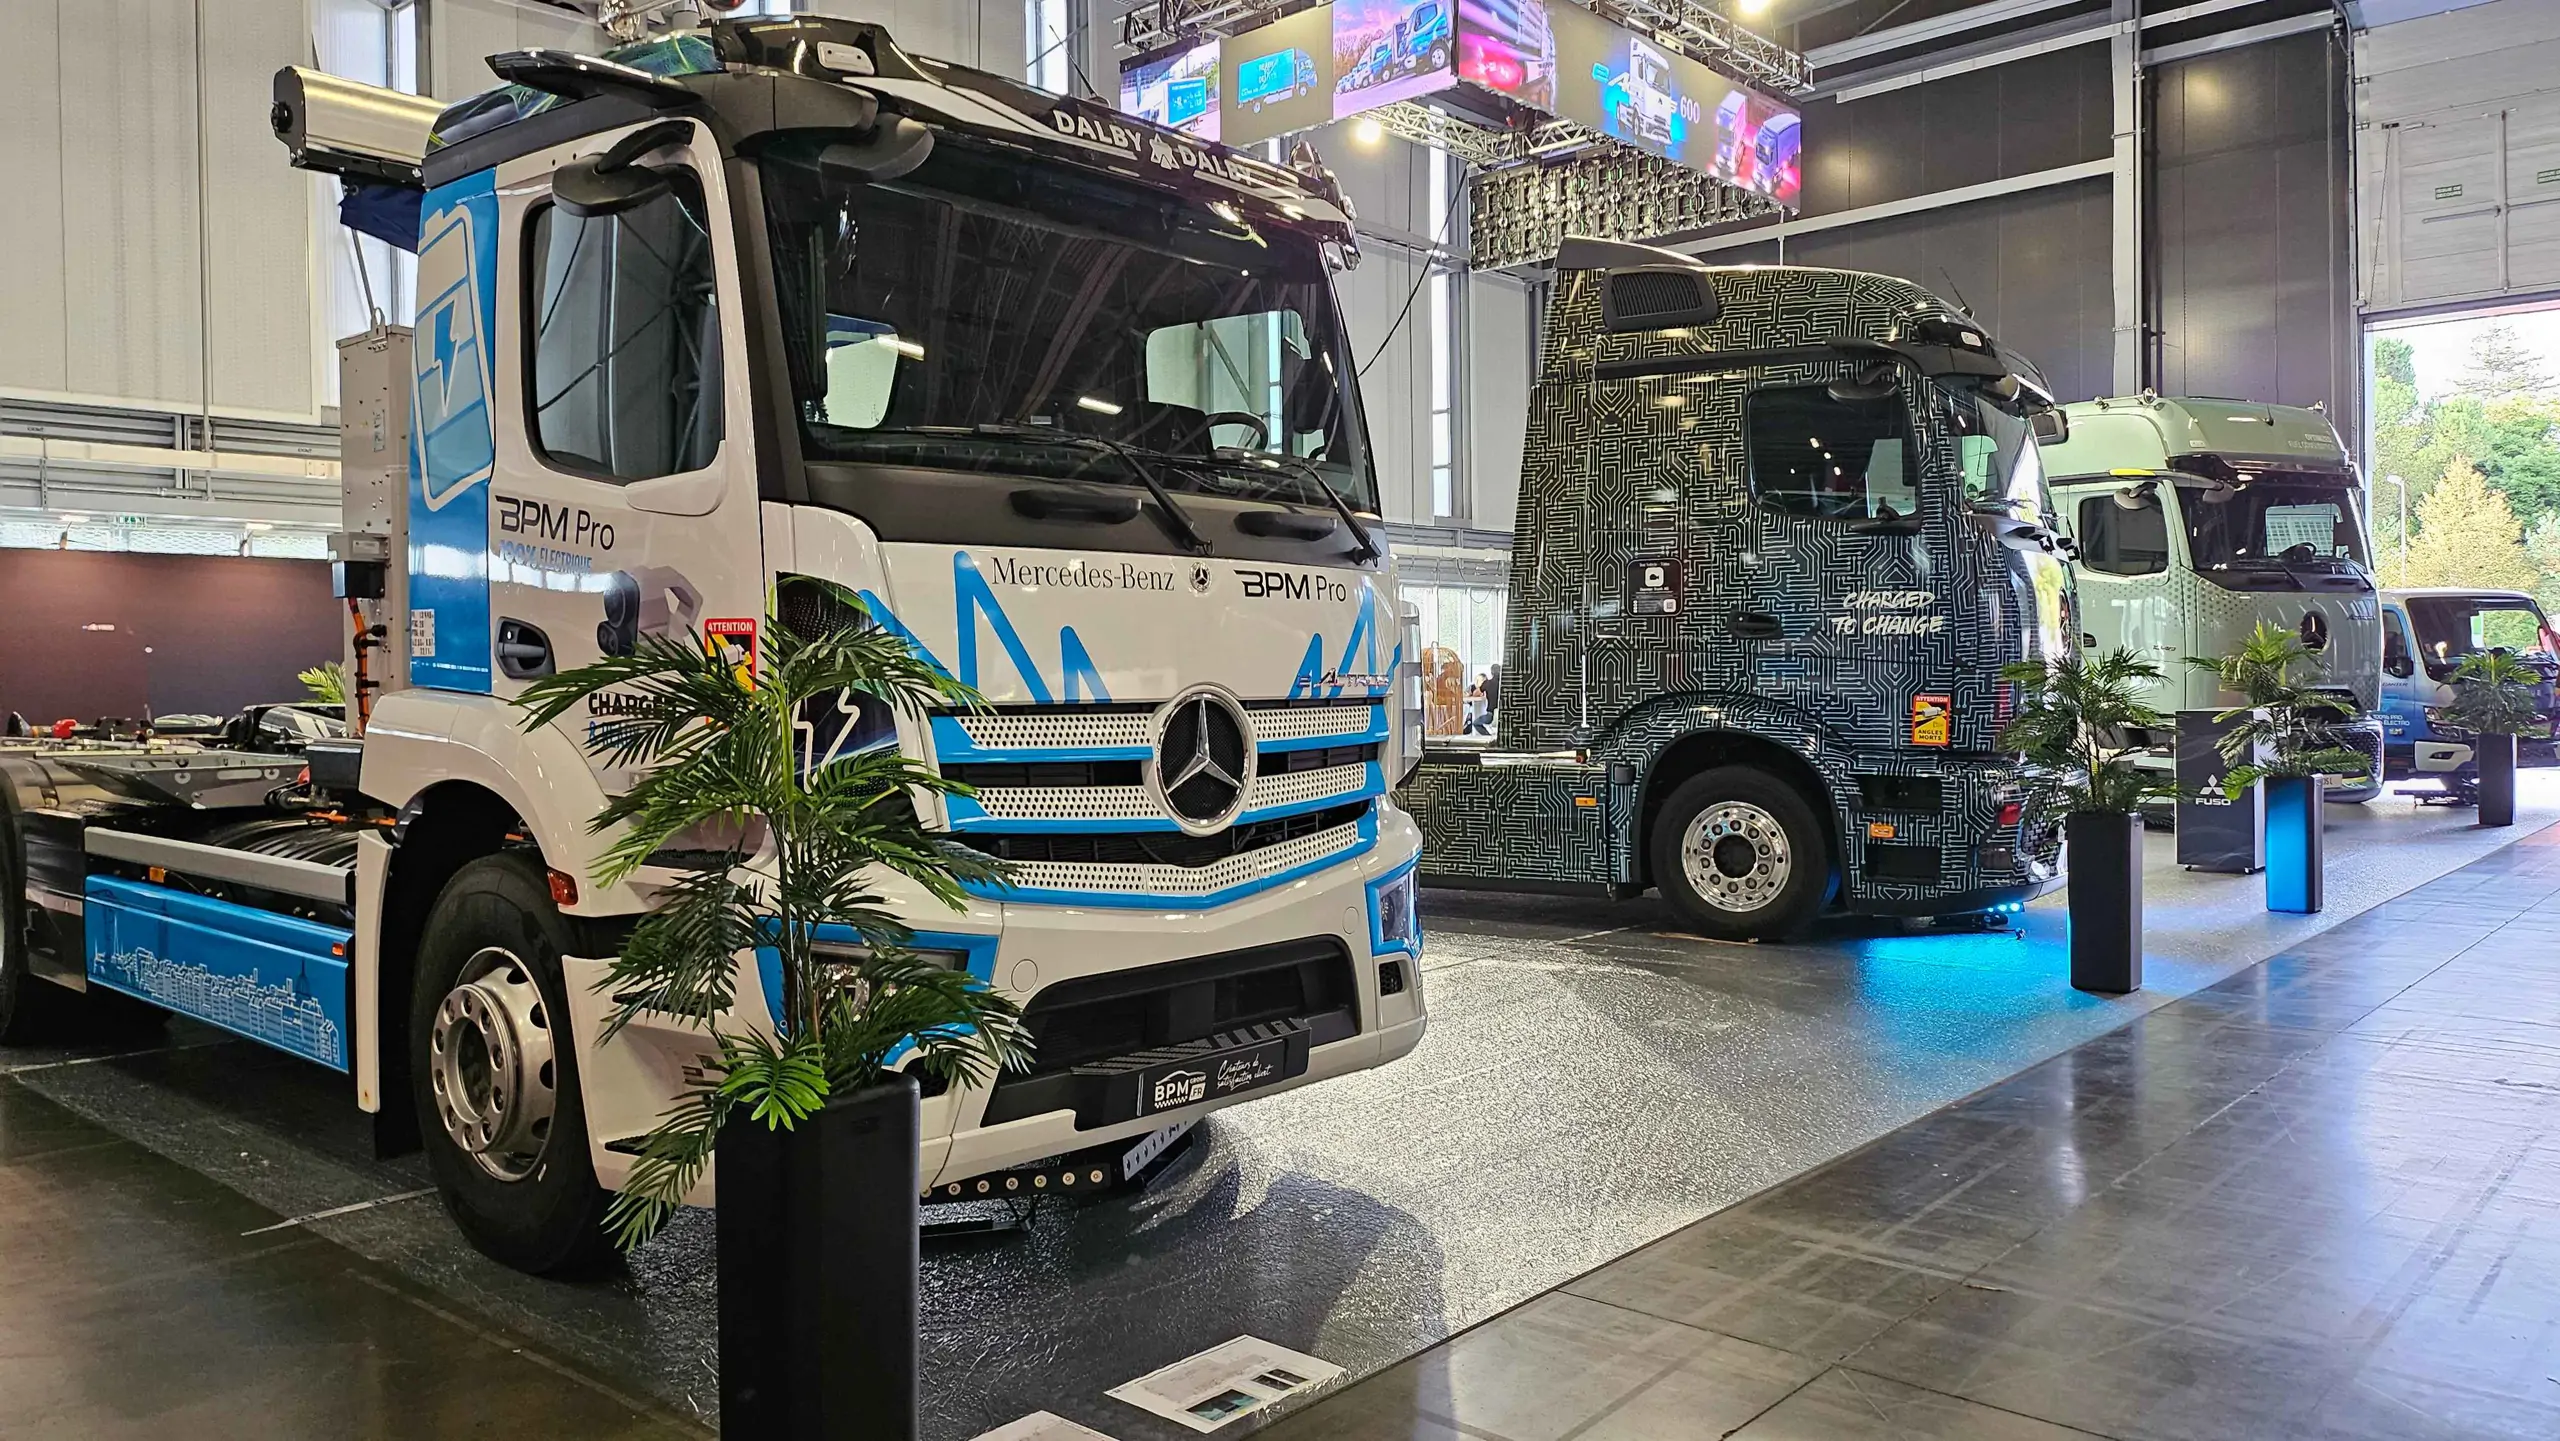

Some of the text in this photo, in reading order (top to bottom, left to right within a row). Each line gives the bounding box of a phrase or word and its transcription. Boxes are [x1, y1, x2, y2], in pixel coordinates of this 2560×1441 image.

[1680, 95, 1700, 124] 600
[1052, 109, 1252, 185] DALBY DALBY
[495, 495, 615, 550] BPM Pro
[990, 556, 1175, 591] Mercedes-Benz
[1233, 569, 1347, 602] BPM Pro
[1843, 590, 1936, 609] CHARGED
[707, 621, 753, 632] ATTENTION
[1831, 615, 1944, 637] TO CHANGE
[2195, 798, 2231, 806] FUSO
[1155, 1079, 1189, 1102] BPM
